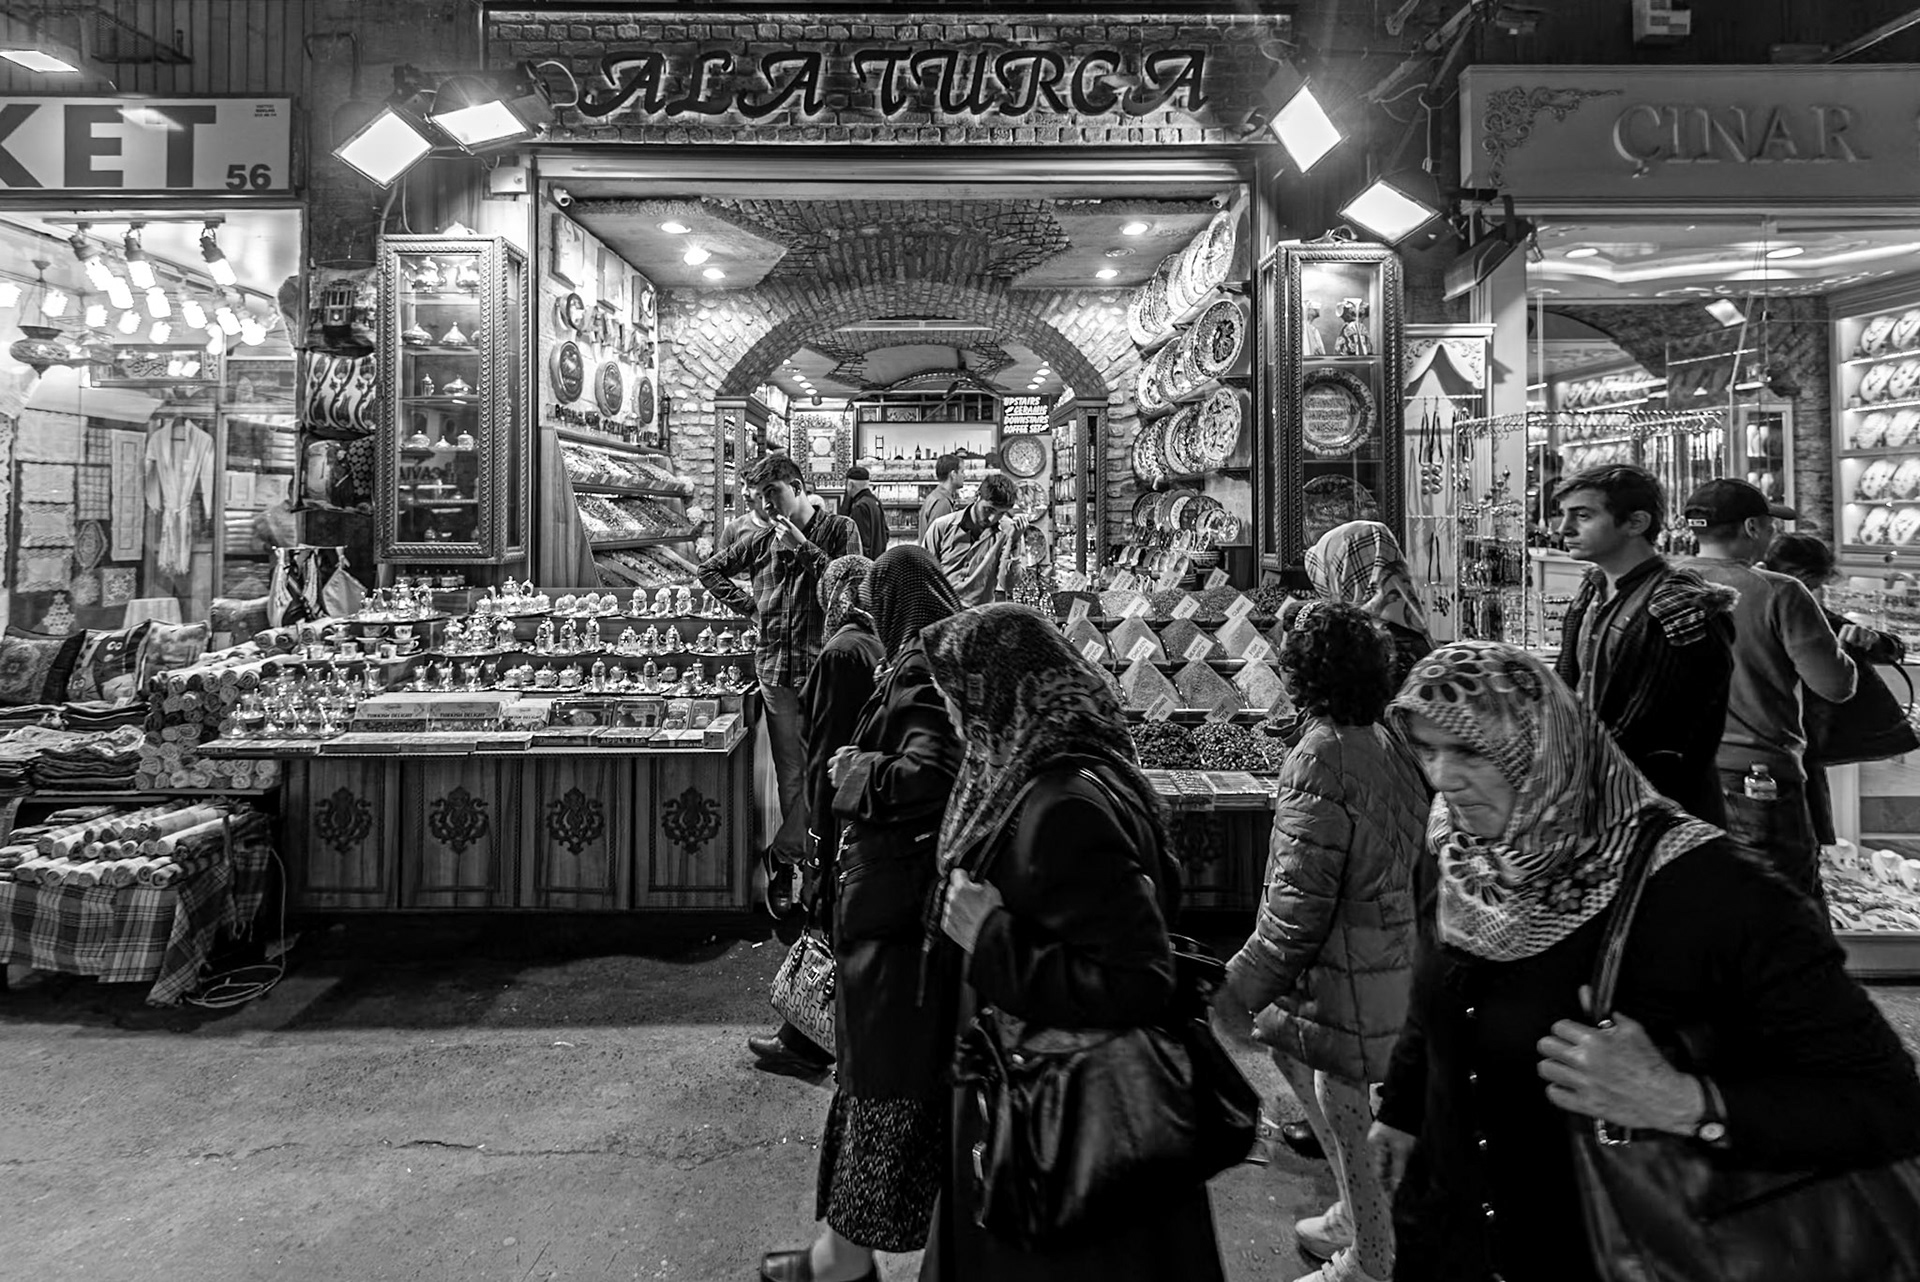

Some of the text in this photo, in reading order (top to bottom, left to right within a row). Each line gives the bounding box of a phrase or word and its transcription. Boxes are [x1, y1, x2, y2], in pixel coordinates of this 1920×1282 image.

[577, 50, 1209, 118] ALA TURCA
[225, 164, 272, 190] 56
[1003, 397, 1041, 406] UPSTAIRS
[1013, 405, 1048, 414] CERAMIC
[1003, 415, 1050, 425] DOWNSTAIRS
[1003, 424, 1042, 433] COFFEE SET
[1178, 600, 1194, 618] CHILLI
[1231, 601, 1246, 617] CURRY
